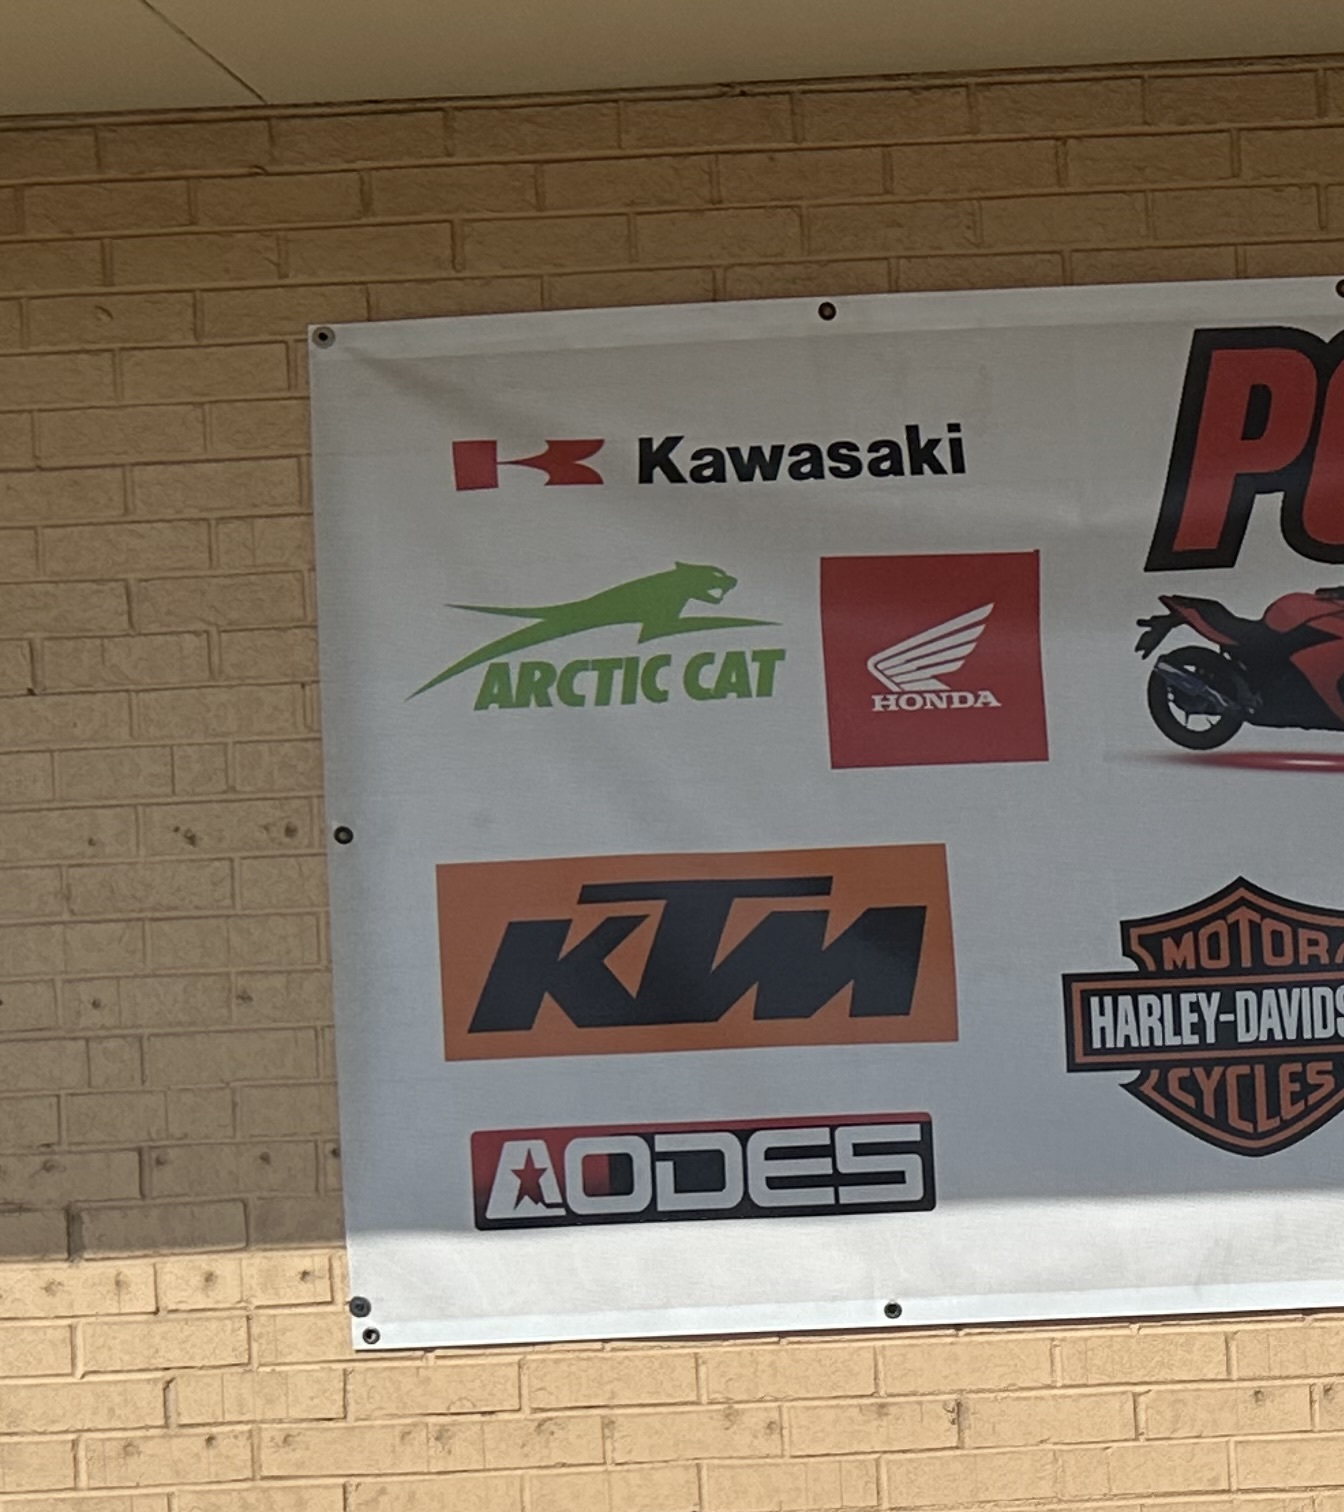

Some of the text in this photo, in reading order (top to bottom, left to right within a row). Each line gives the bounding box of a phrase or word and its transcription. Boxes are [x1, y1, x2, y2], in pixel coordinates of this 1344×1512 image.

[636, 422, 967, 485] Kawasaki
[473, 648, 787, 712] ARCTIC CAT
[871, 689, 1002, 712] HONDA
[466, 875, 928, 1035] KTM
[1161, 904, 1331, 972] MOTOR
[1167, 1060, 1336, 1134] CYCLES
[484, 1122, 926, 1221] AODES
